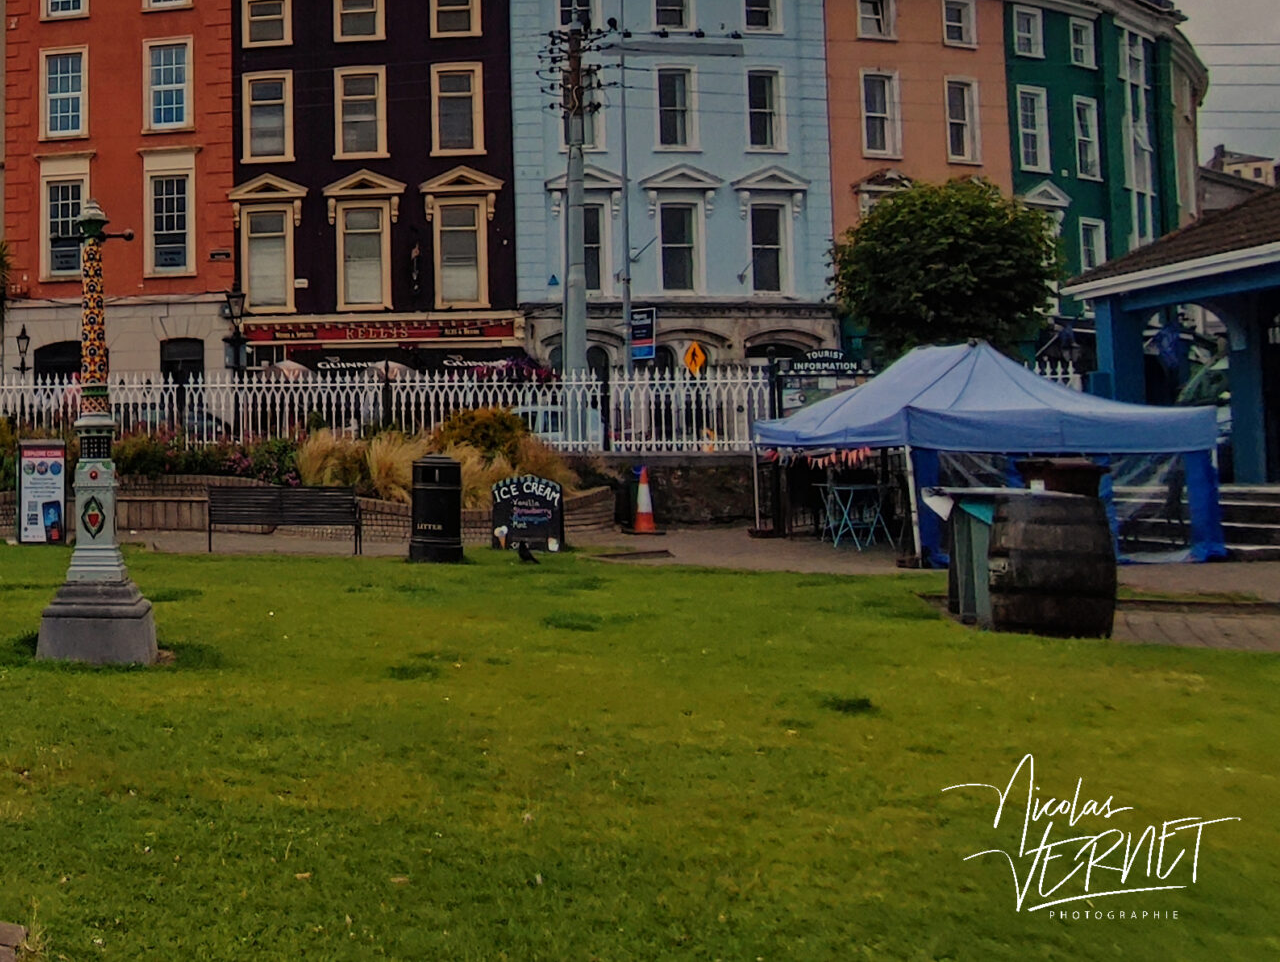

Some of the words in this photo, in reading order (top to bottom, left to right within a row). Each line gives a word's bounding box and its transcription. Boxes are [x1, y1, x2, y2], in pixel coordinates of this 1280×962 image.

[806, 350, 844, 360] TOURIST
[793, 362, 857, 370] INFORMATION
[494, 484, 519, 503] ICE
[523, 481, 560, 507] CREAM
